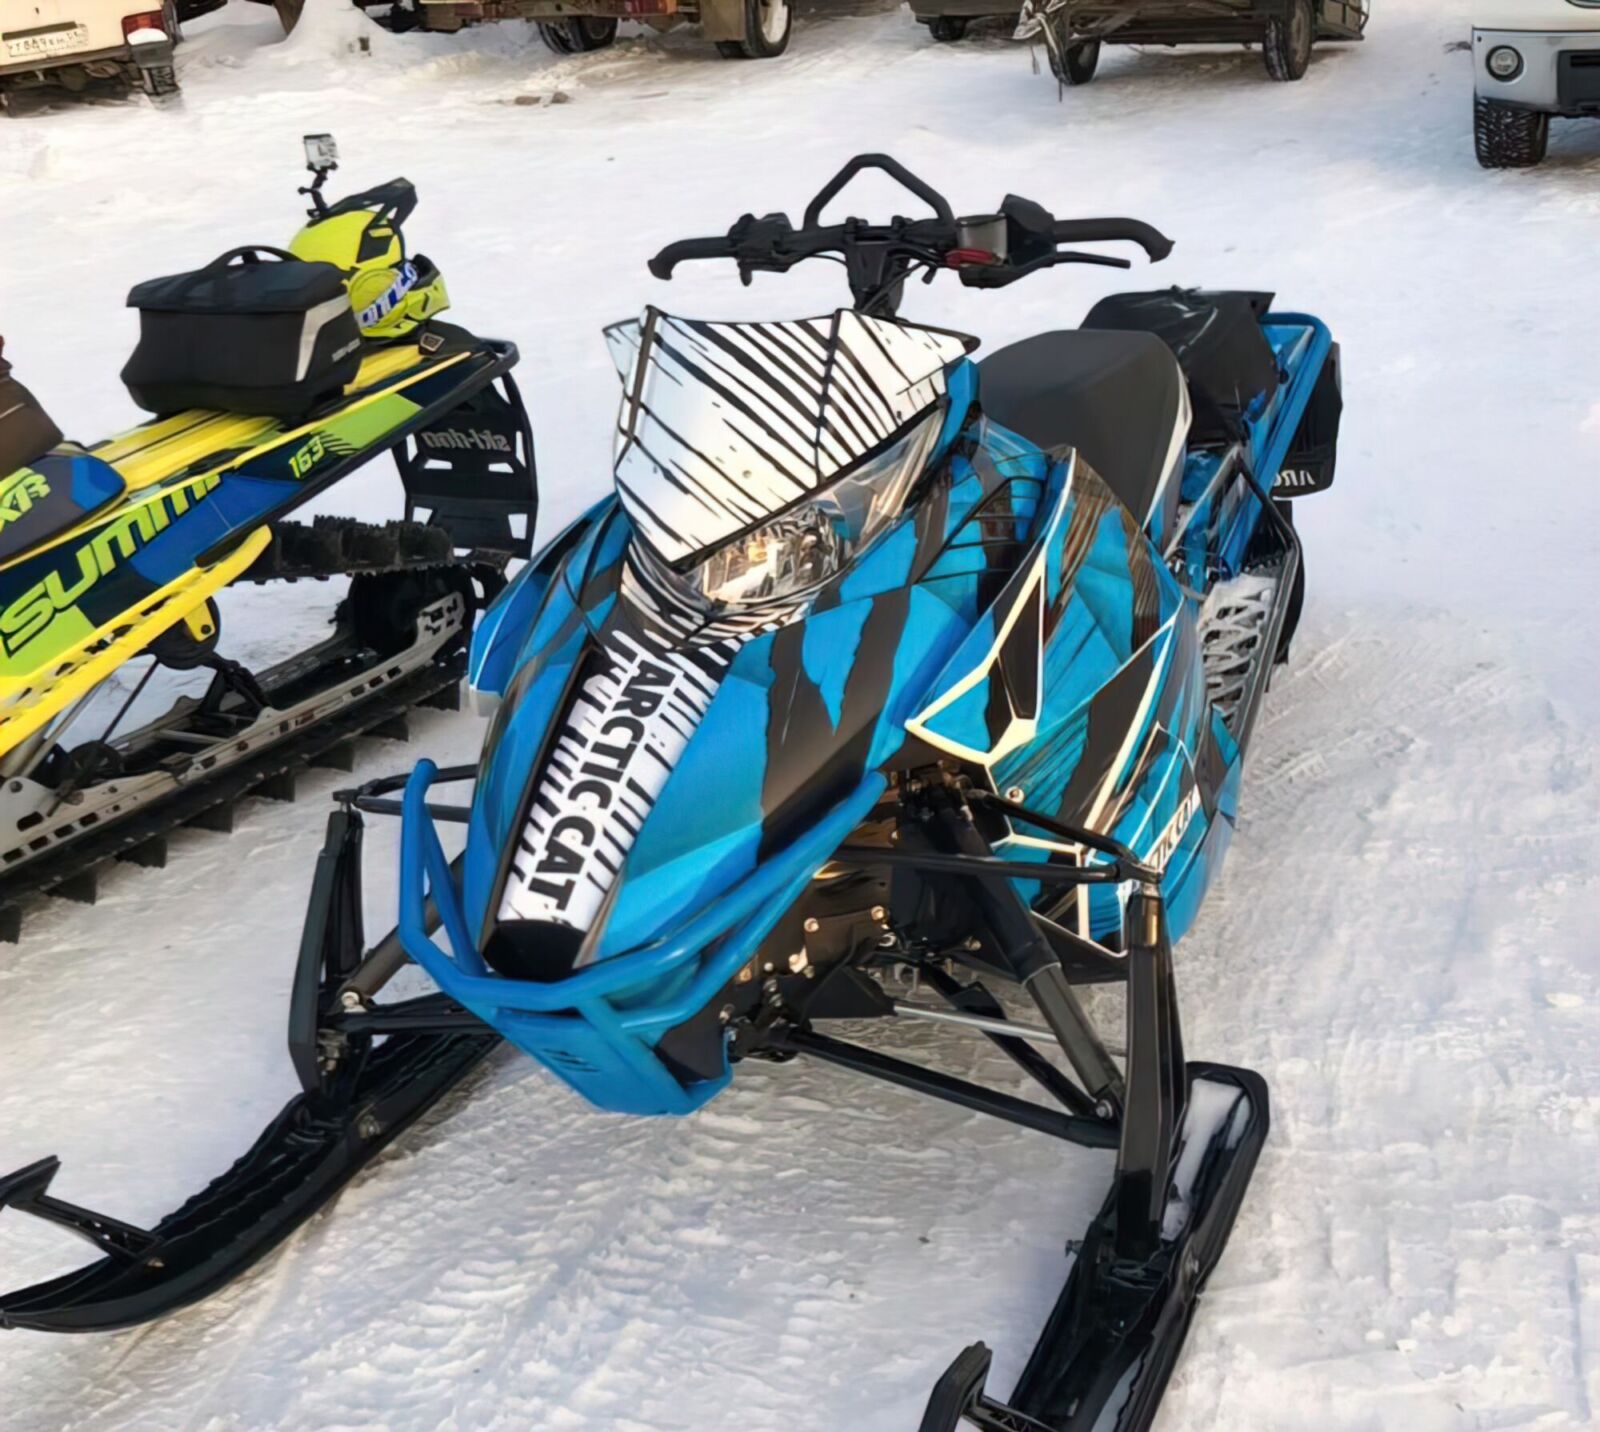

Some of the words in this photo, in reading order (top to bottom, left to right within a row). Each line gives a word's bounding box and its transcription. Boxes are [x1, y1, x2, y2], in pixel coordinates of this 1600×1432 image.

[288, 435, 325, 479] 163
[568, 660, 676, 809] ARCTIC
[527, 815, 596, 911] CAT
